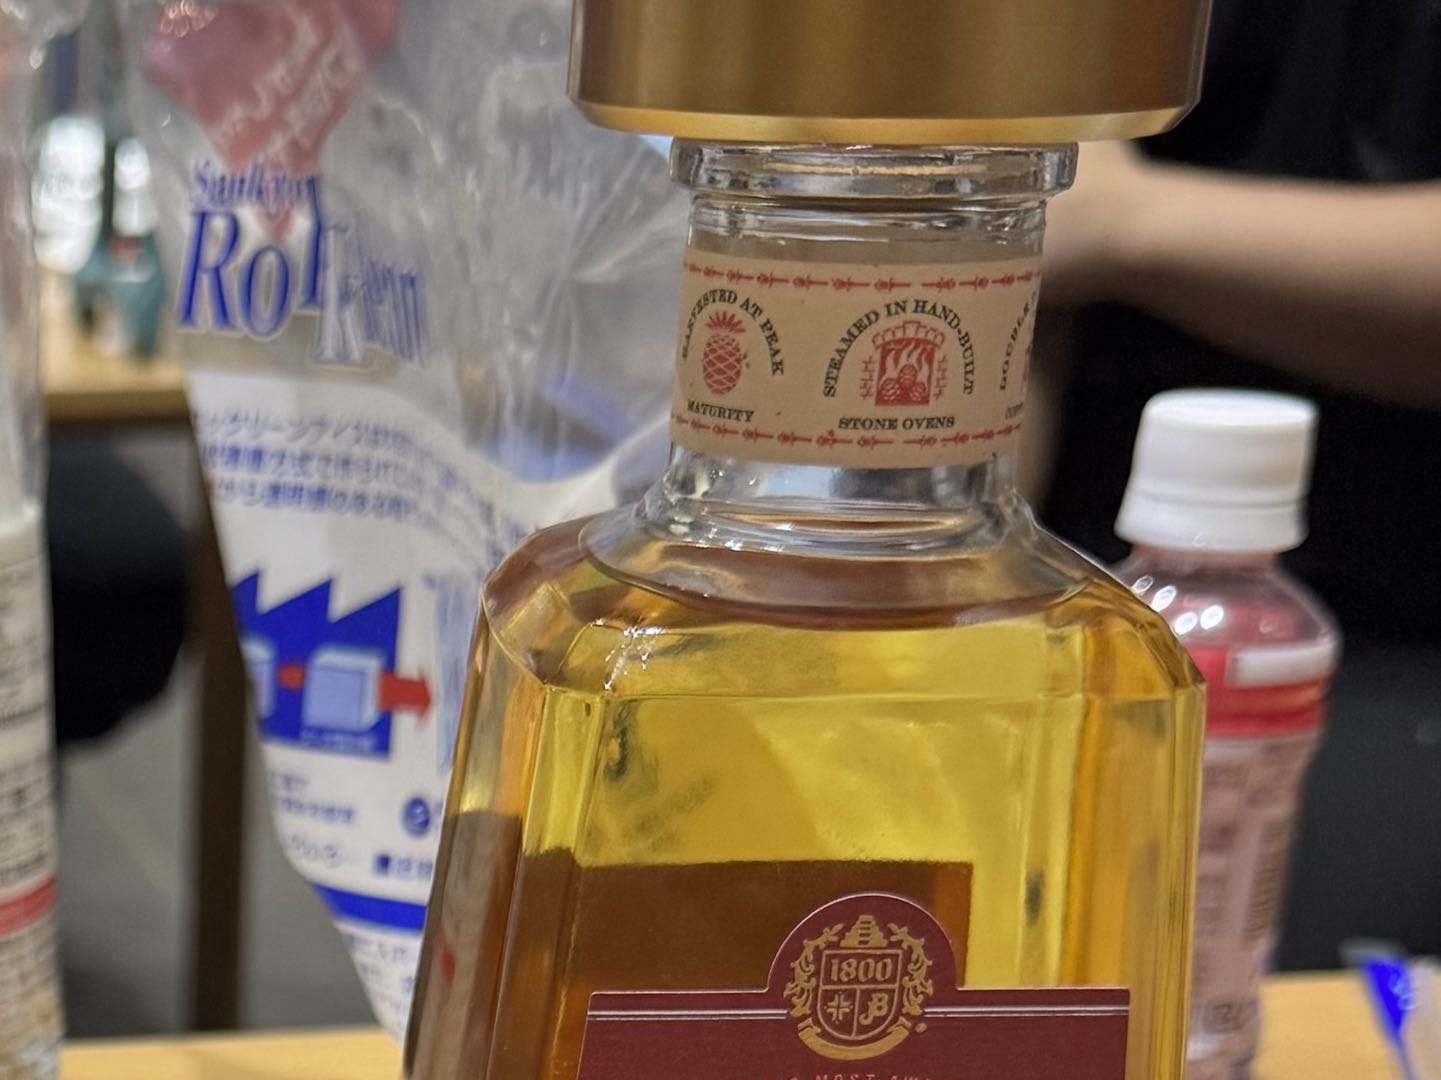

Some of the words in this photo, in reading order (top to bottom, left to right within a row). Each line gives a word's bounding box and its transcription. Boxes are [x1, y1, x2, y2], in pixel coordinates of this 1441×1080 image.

[739, 297, 763, 320] AT
[760, 317, 784, 376] PEAK
[823, 309, 880, 398] STEAMED
[885, 299, 908, 318] IN
[912, 299, 975, 395] HAND-BUILT
[686, 399, 755, 422] MATURITY
[838, 416, 898, 431] STONE
[902, 415, 955, 430] OVENS
[830, 957, 893, 982] 1800
